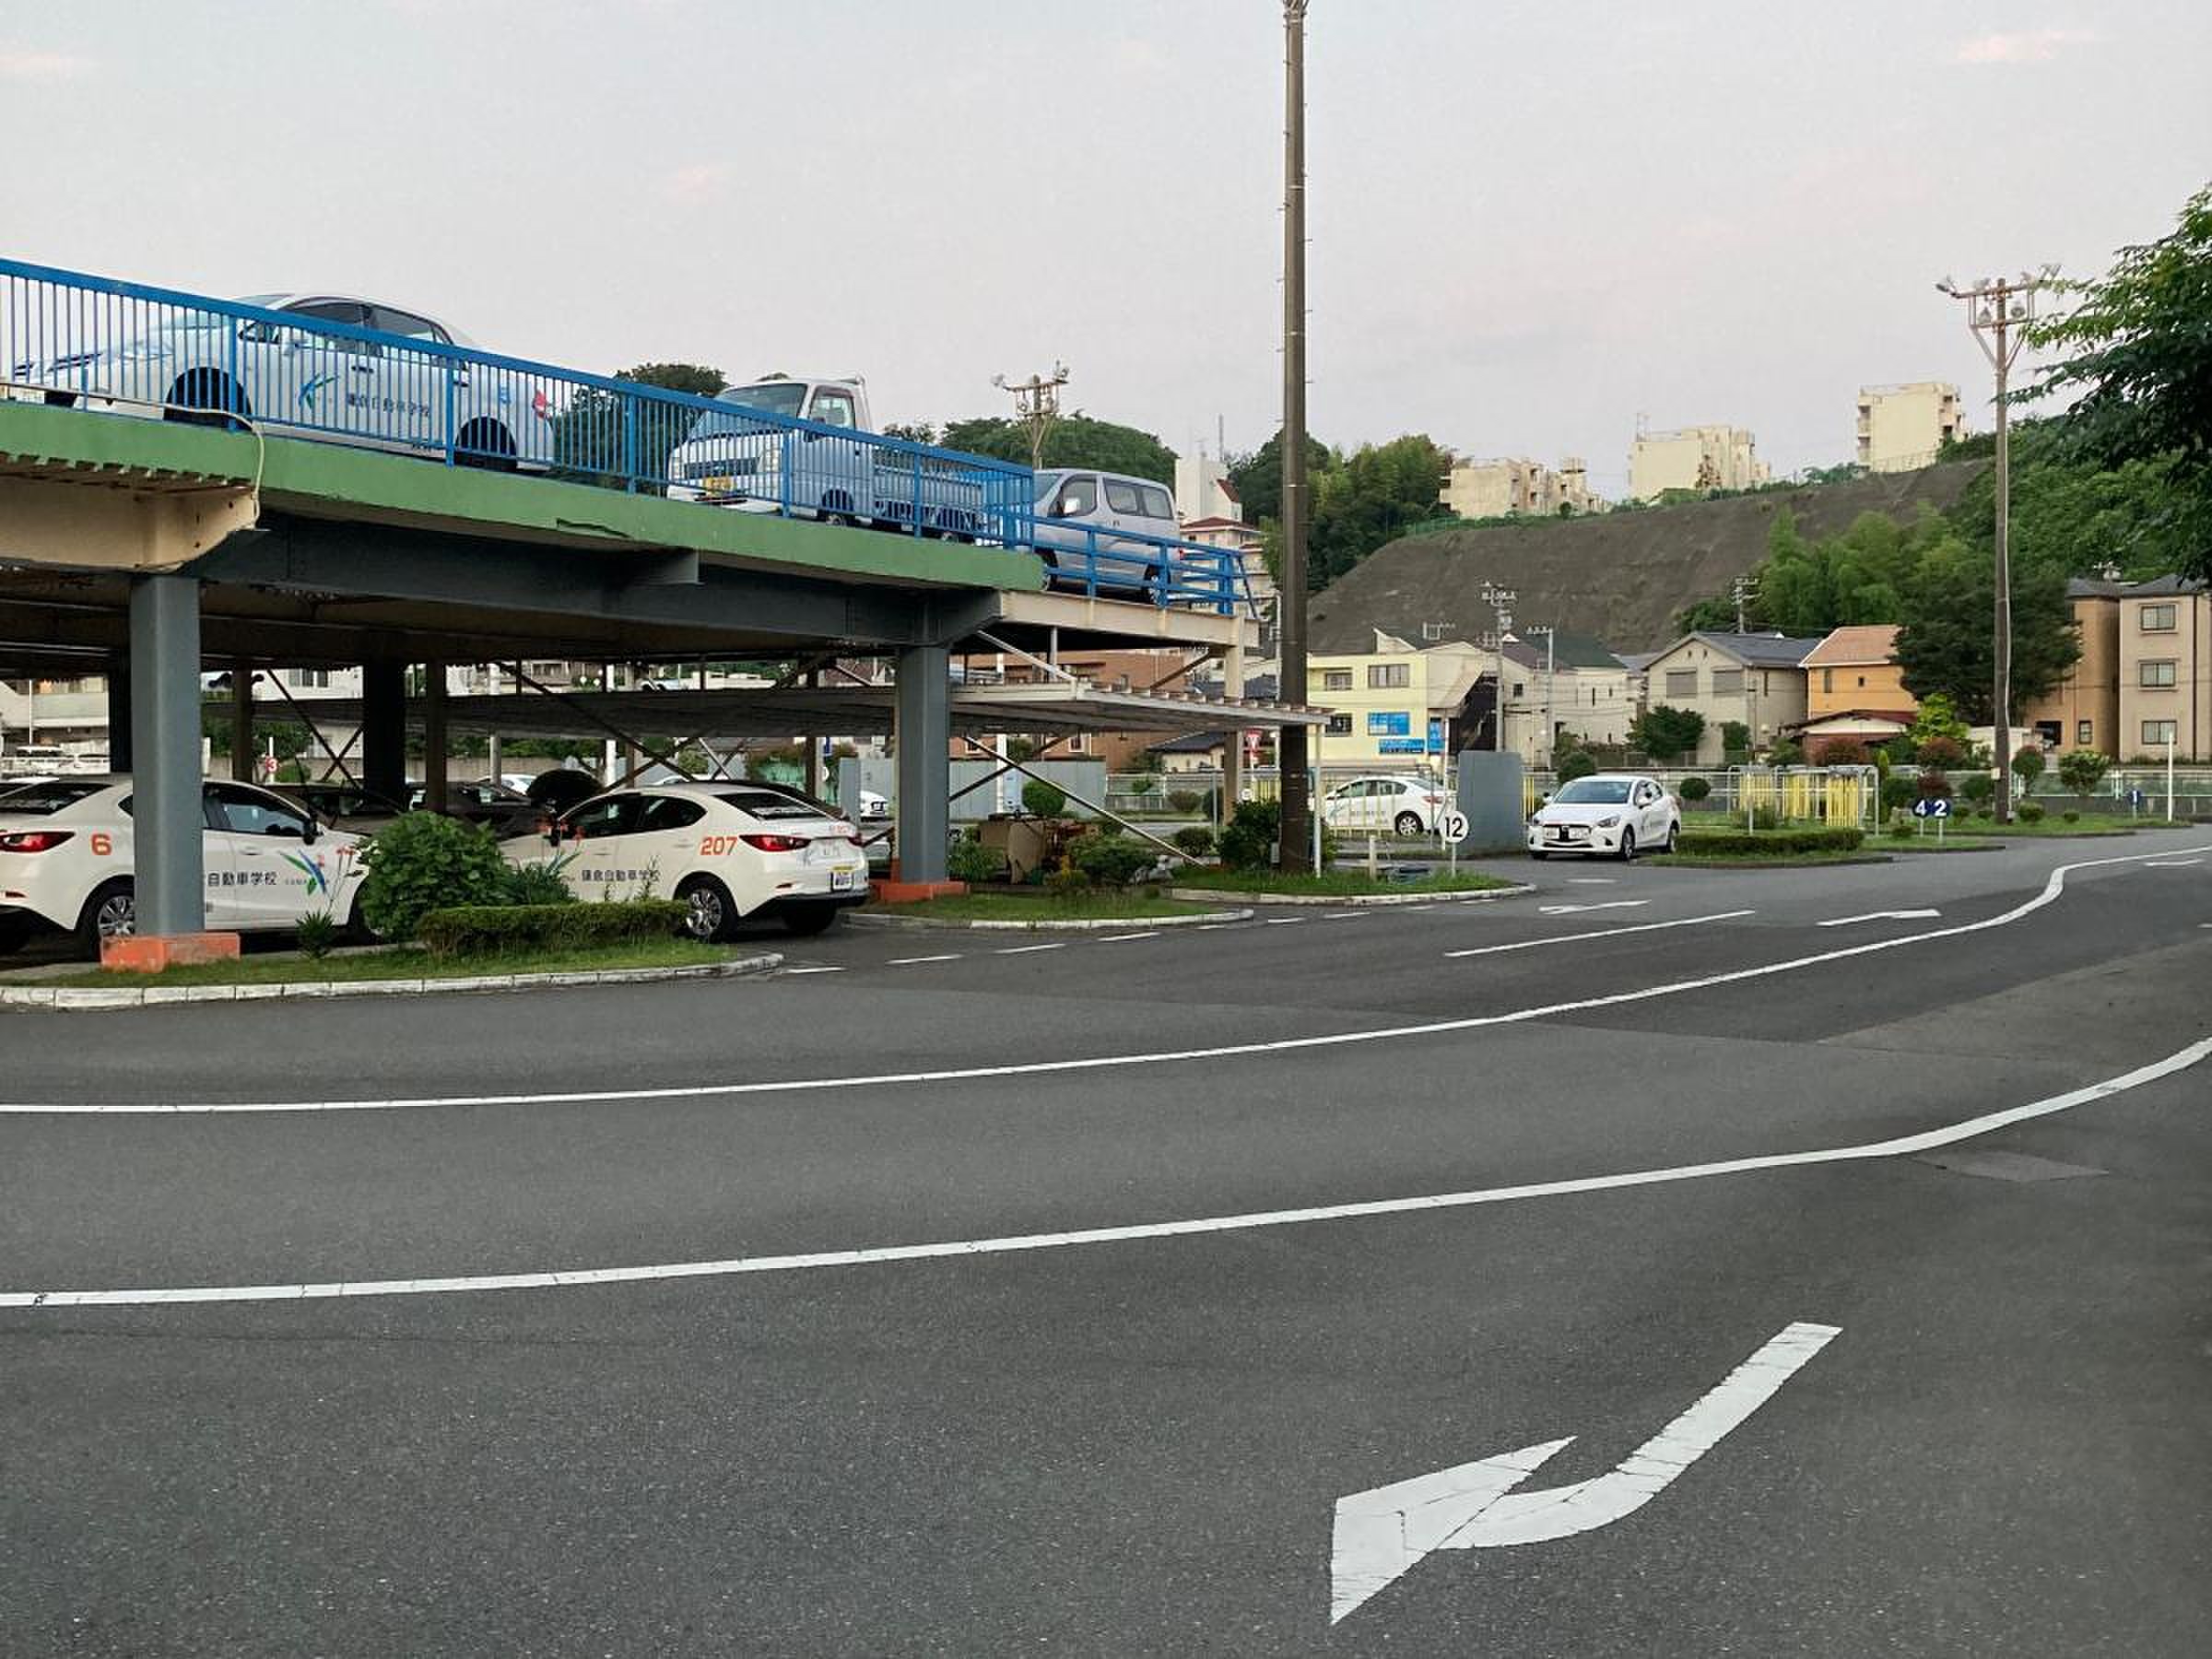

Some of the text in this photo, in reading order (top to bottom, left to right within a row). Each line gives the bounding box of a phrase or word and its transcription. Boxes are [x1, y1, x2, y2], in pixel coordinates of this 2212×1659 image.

[1915, 799, 1927, 816] 4
[1934, 799, 1947, 817] 2
[1445, 817, 1463, 837] 12
[92, 833, 112, 855] 6
[700, 836, 737, 856] 207
